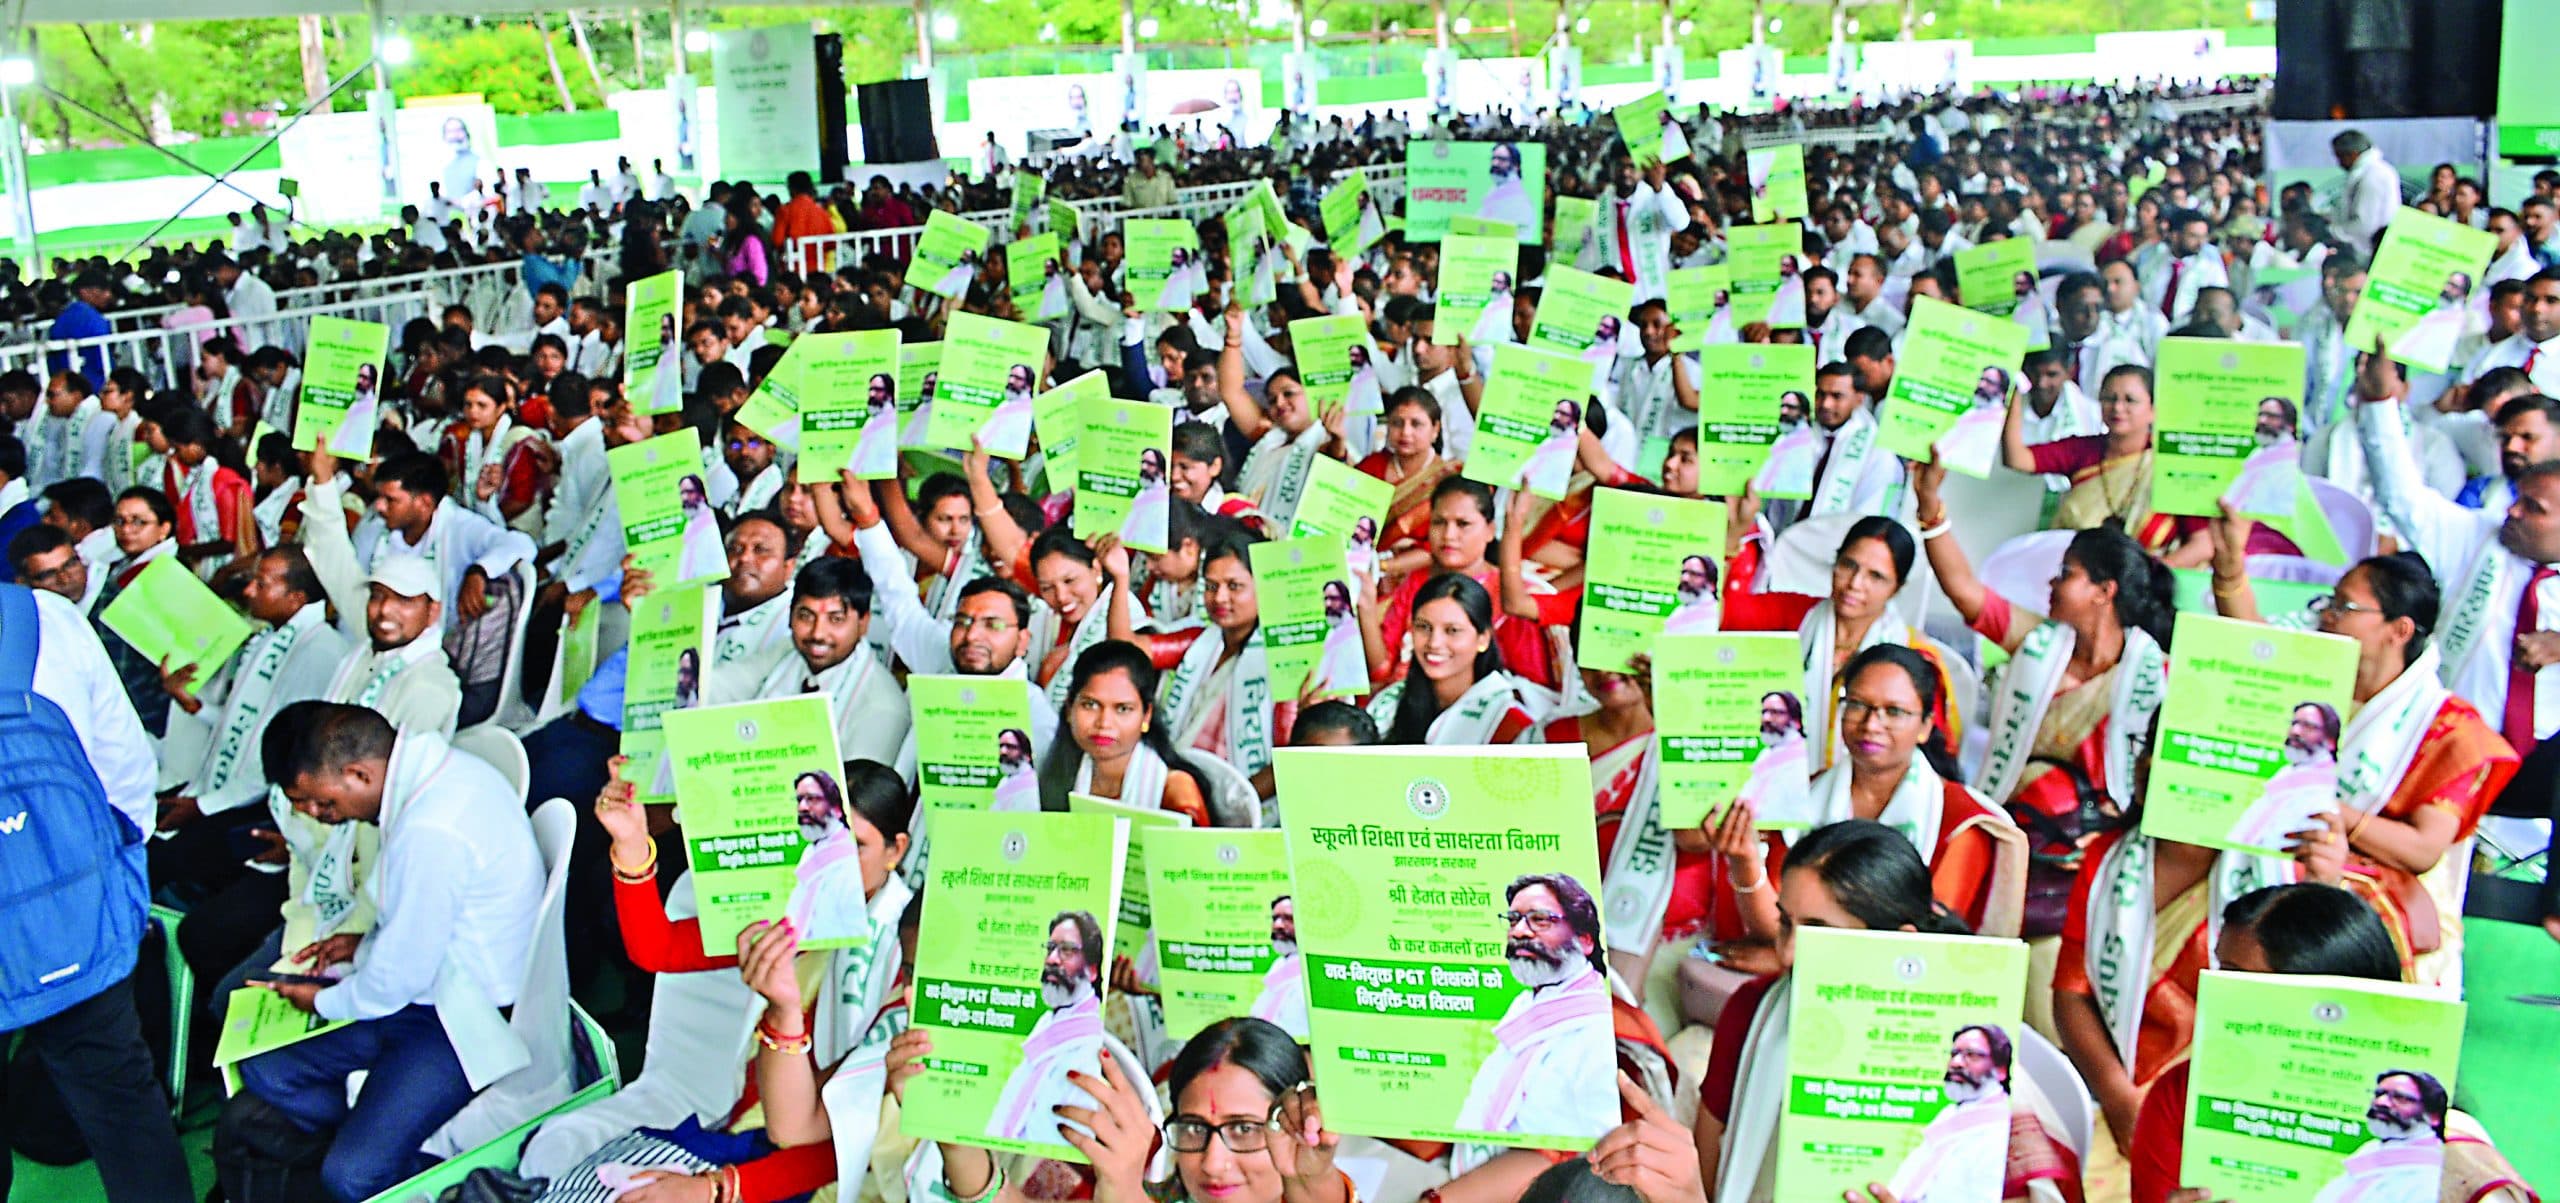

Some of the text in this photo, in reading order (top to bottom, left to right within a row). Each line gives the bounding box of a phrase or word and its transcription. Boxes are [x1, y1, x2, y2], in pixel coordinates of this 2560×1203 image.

[1311, 823, 1560, 852] स्कूली शिक्षा एवं साक्षरता विभाग
[1388, 884, 1406, 904] श्री
[1450, 886, 1491, 906] सोरेन
[1388, 935, 1400, 952] के
[1404, 938, 1425, 953] कर
[1395, 969, 1425, 986] PGT
[1430, 964, 1480, 989] शिक्षकों
[1483, 970, 1503, 989] को
[1429, 994, 1474, 1013] वितरण
